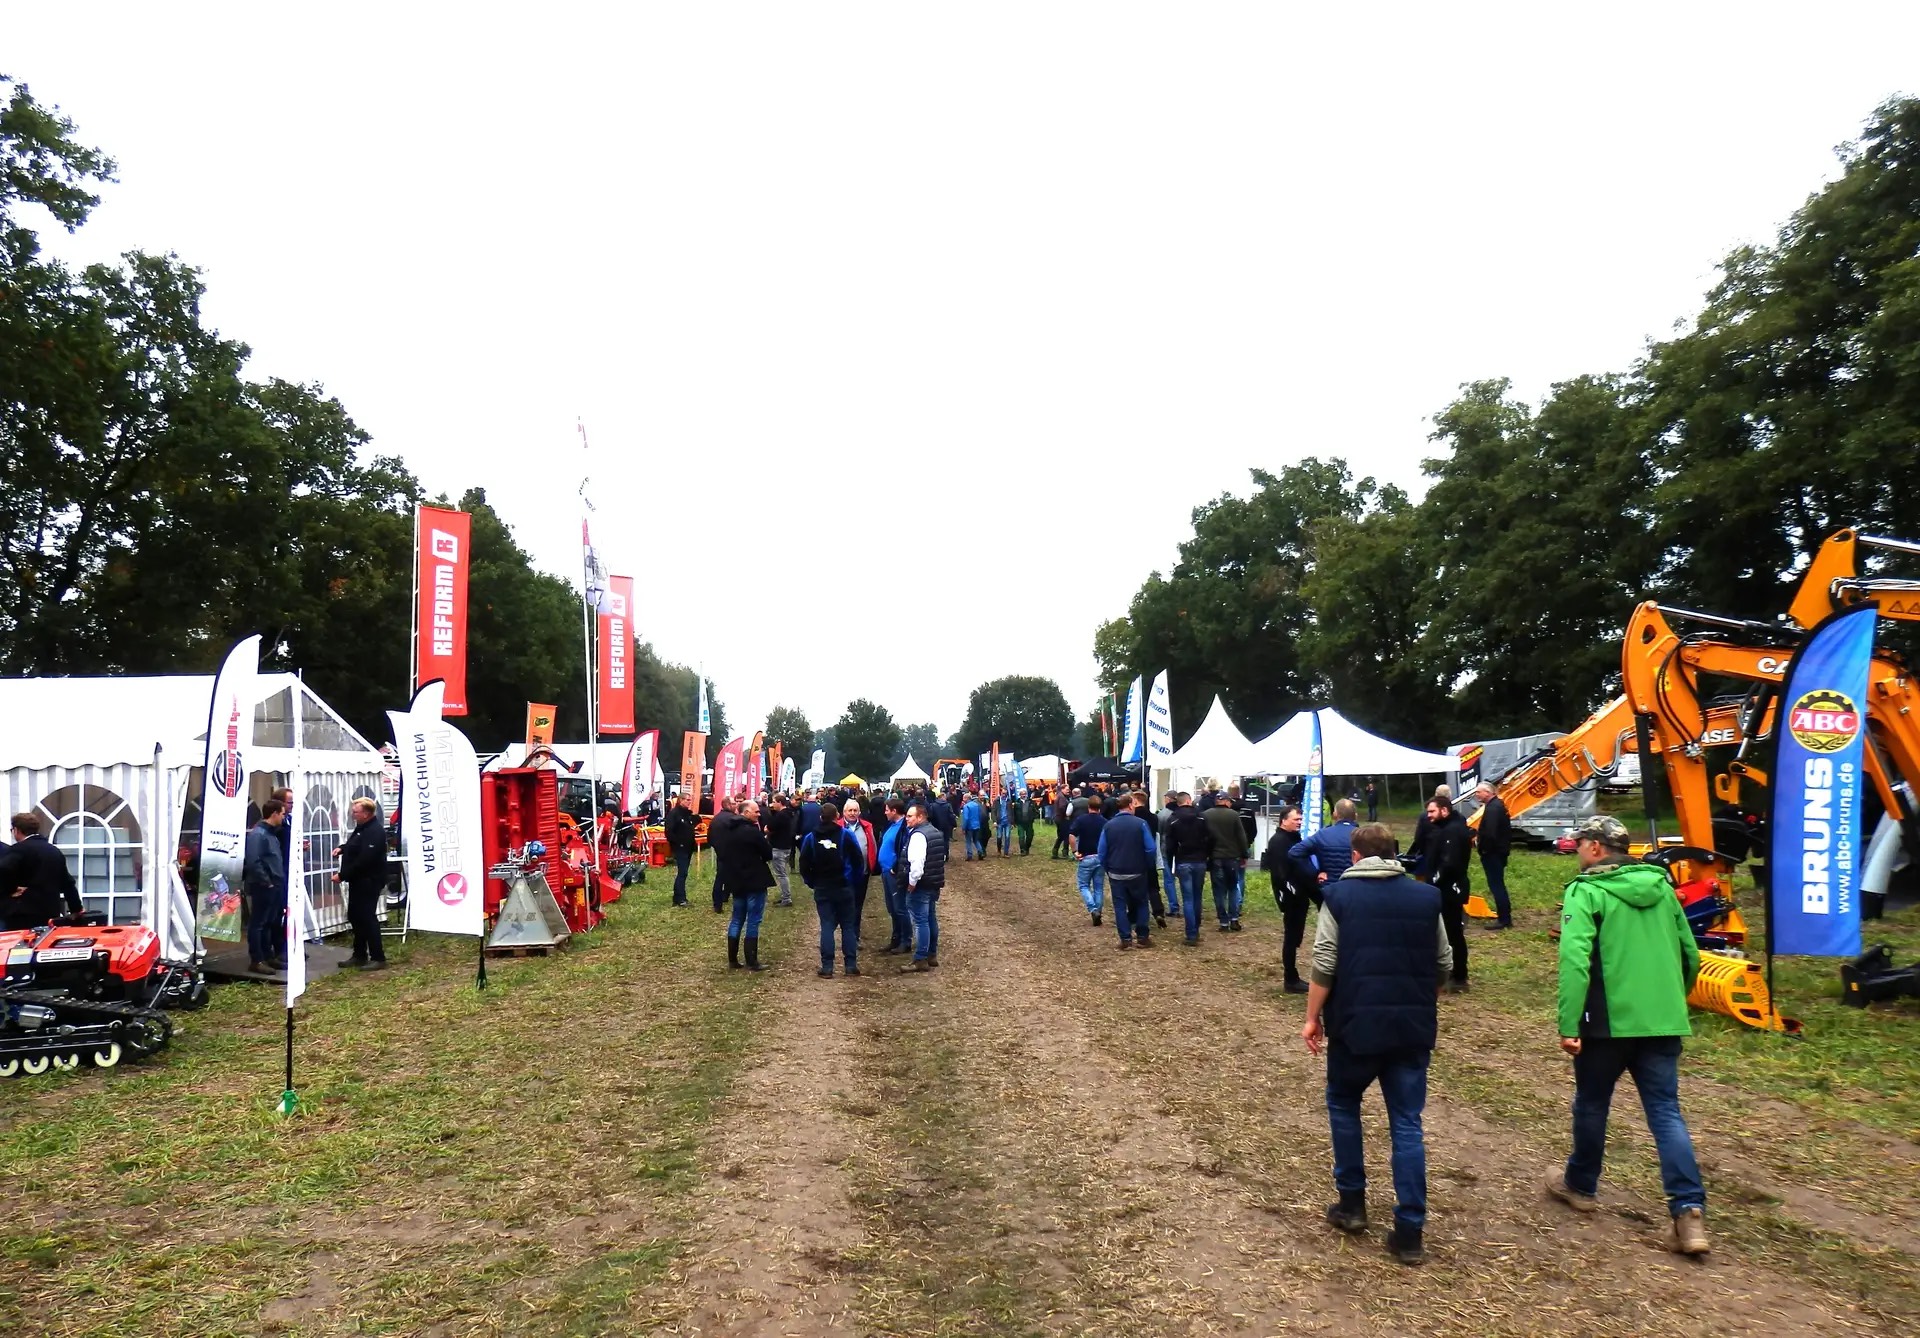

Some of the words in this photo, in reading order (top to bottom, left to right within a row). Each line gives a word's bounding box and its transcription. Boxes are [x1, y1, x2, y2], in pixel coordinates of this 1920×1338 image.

[433, 565, 454, 656] REFORM
[610, 618, 625, 689] REFORM
[1757, 657, 1790, 675] CA
[1701, 728, 1735, 744] ASE
[1792, 711, 1857, 732] ABC
[1802, 758, 1833, 914] BRUNS
[1834, 762, 1854, 914] www.abc-bruns.de
